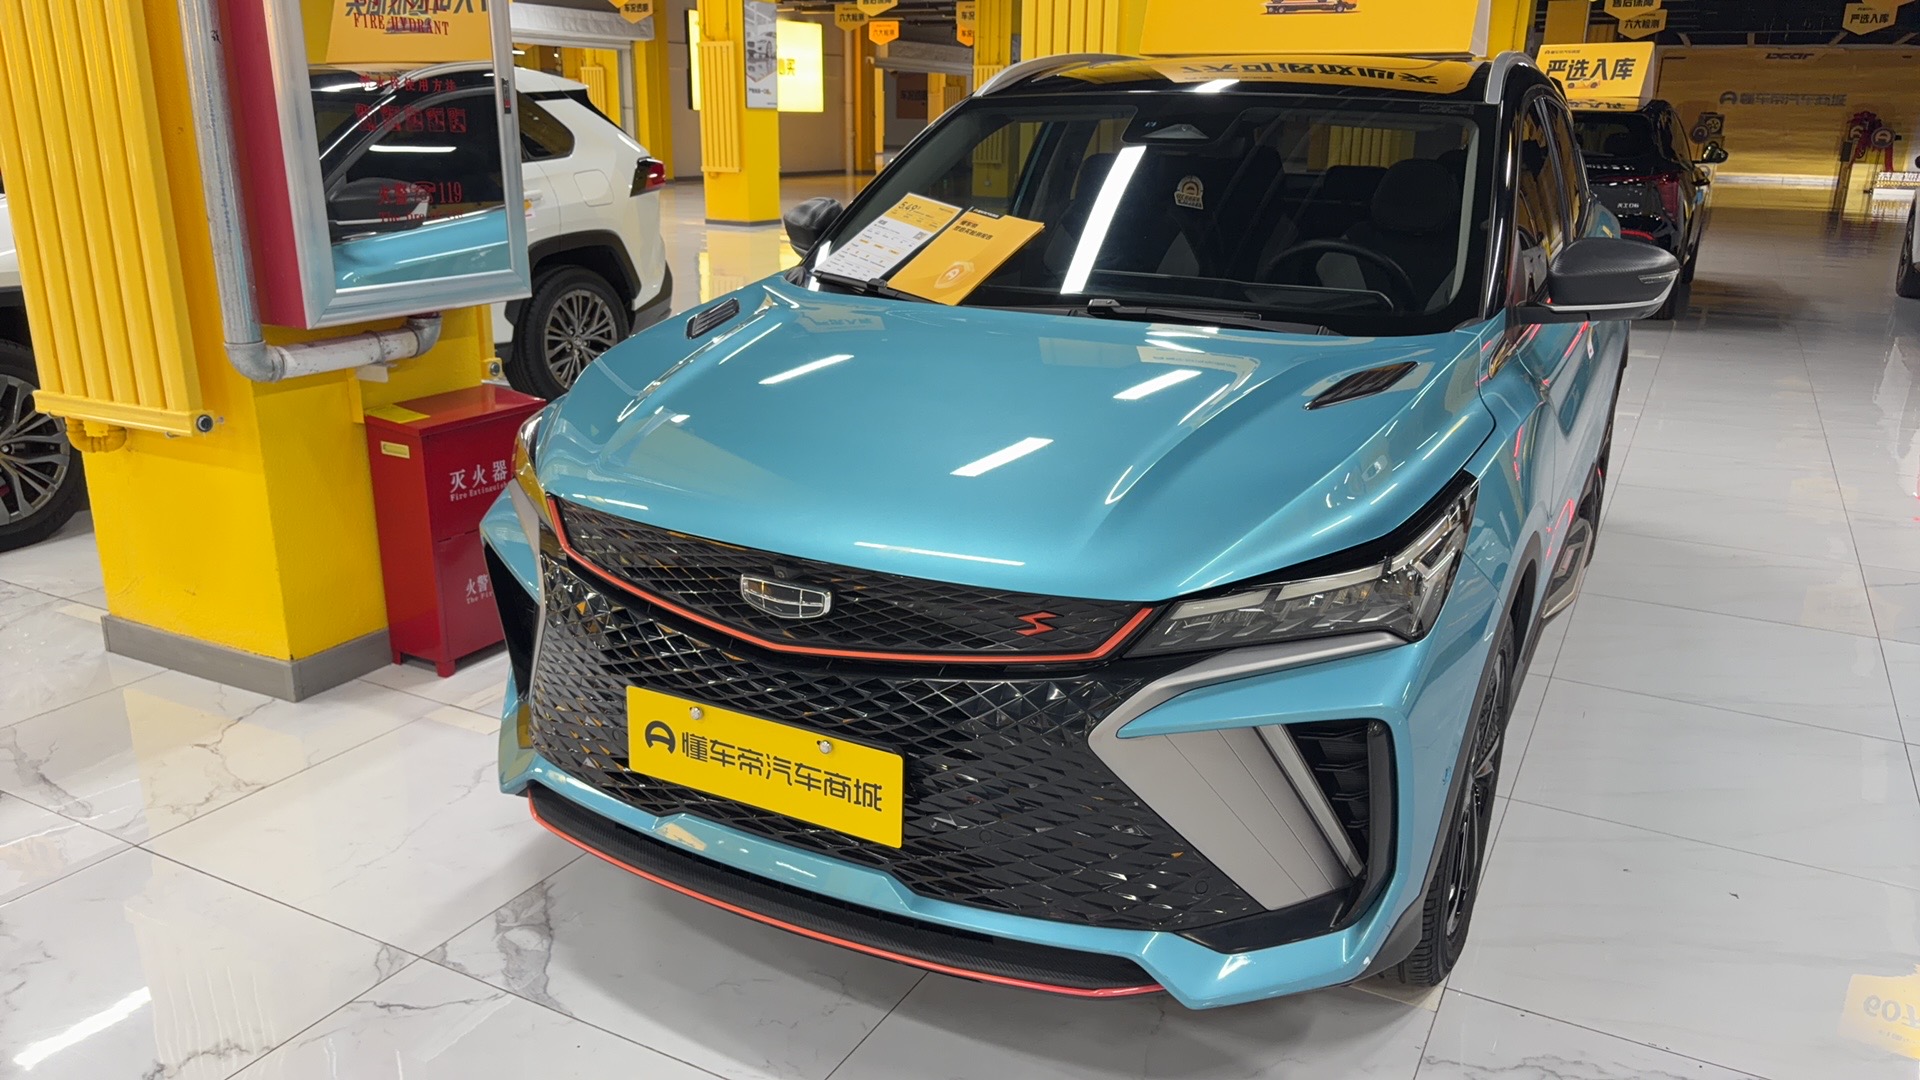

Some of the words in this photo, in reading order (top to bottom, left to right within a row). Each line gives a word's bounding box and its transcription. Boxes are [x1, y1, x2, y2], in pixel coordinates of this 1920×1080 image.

[353, 12, 386, 30] FIRE
[390, 16, 450, 36] HYDRANT
[1545, 57, 1637, 81] 严选入库
[439, 181, 464, 204] 119
[449, 459, 508, 494] 灭火器
[450, 492, 468, 502] Fire
[469, 480, 507, 498] Extinguish
[681, 731, 883, 812] 懂车帝汽车商城
